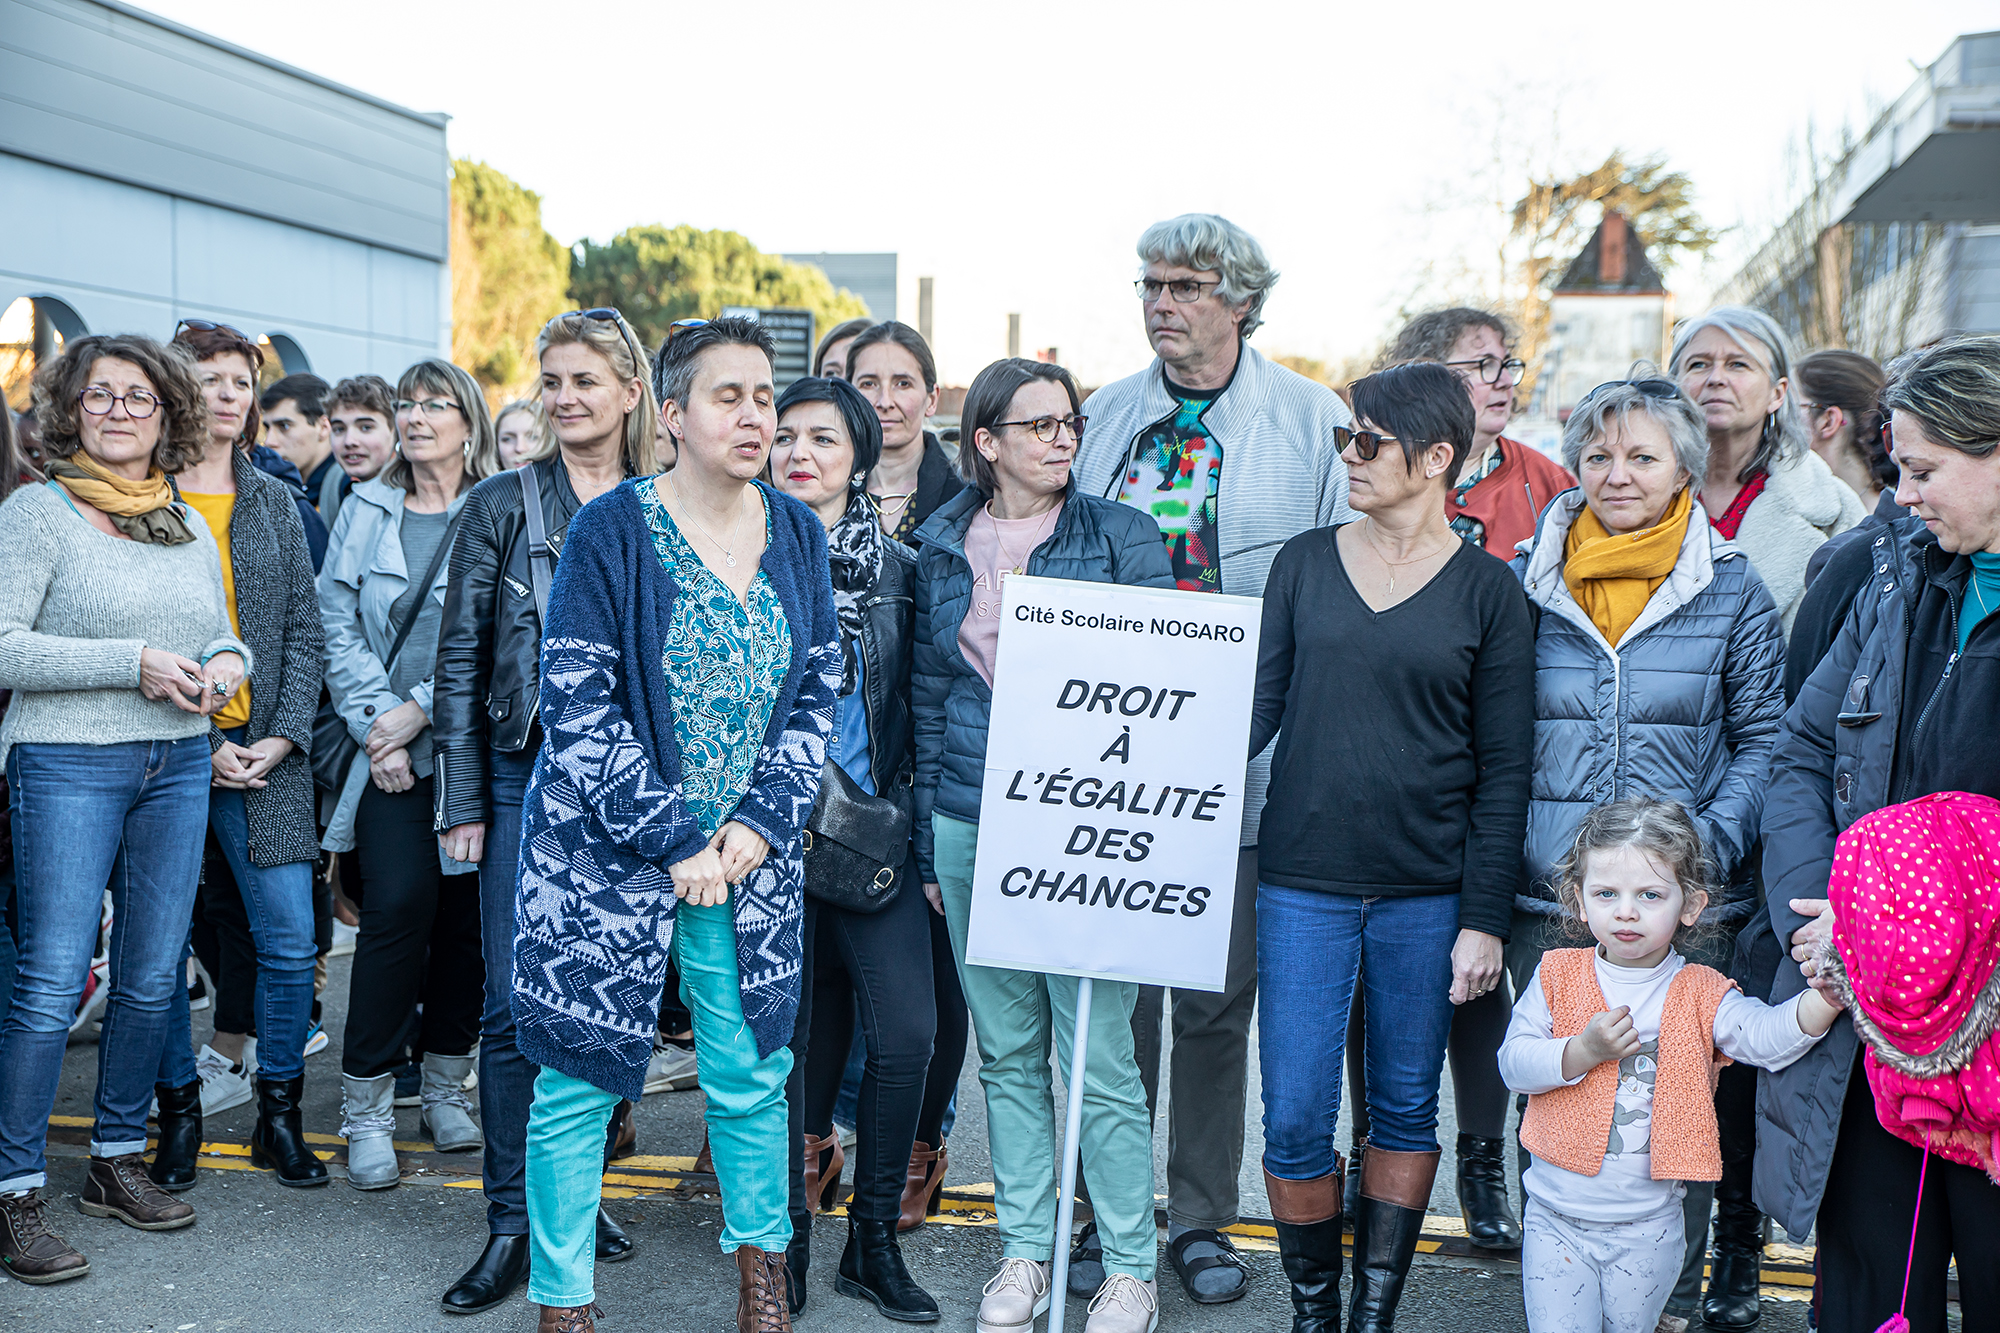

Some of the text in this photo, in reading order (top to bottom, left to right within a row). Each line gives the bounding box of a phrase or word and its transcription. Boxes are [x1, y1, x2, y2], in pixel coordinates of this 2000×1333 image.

[1014, 605, 1245, 643] Cité Scolaire NOGARO
[1056, 679, 1197, 721] DROIT
[1099, 725, 1131, 765] À
[1064, 824, 1155, 863] DES
[1000, 866, 1211, 918] CHANCES
